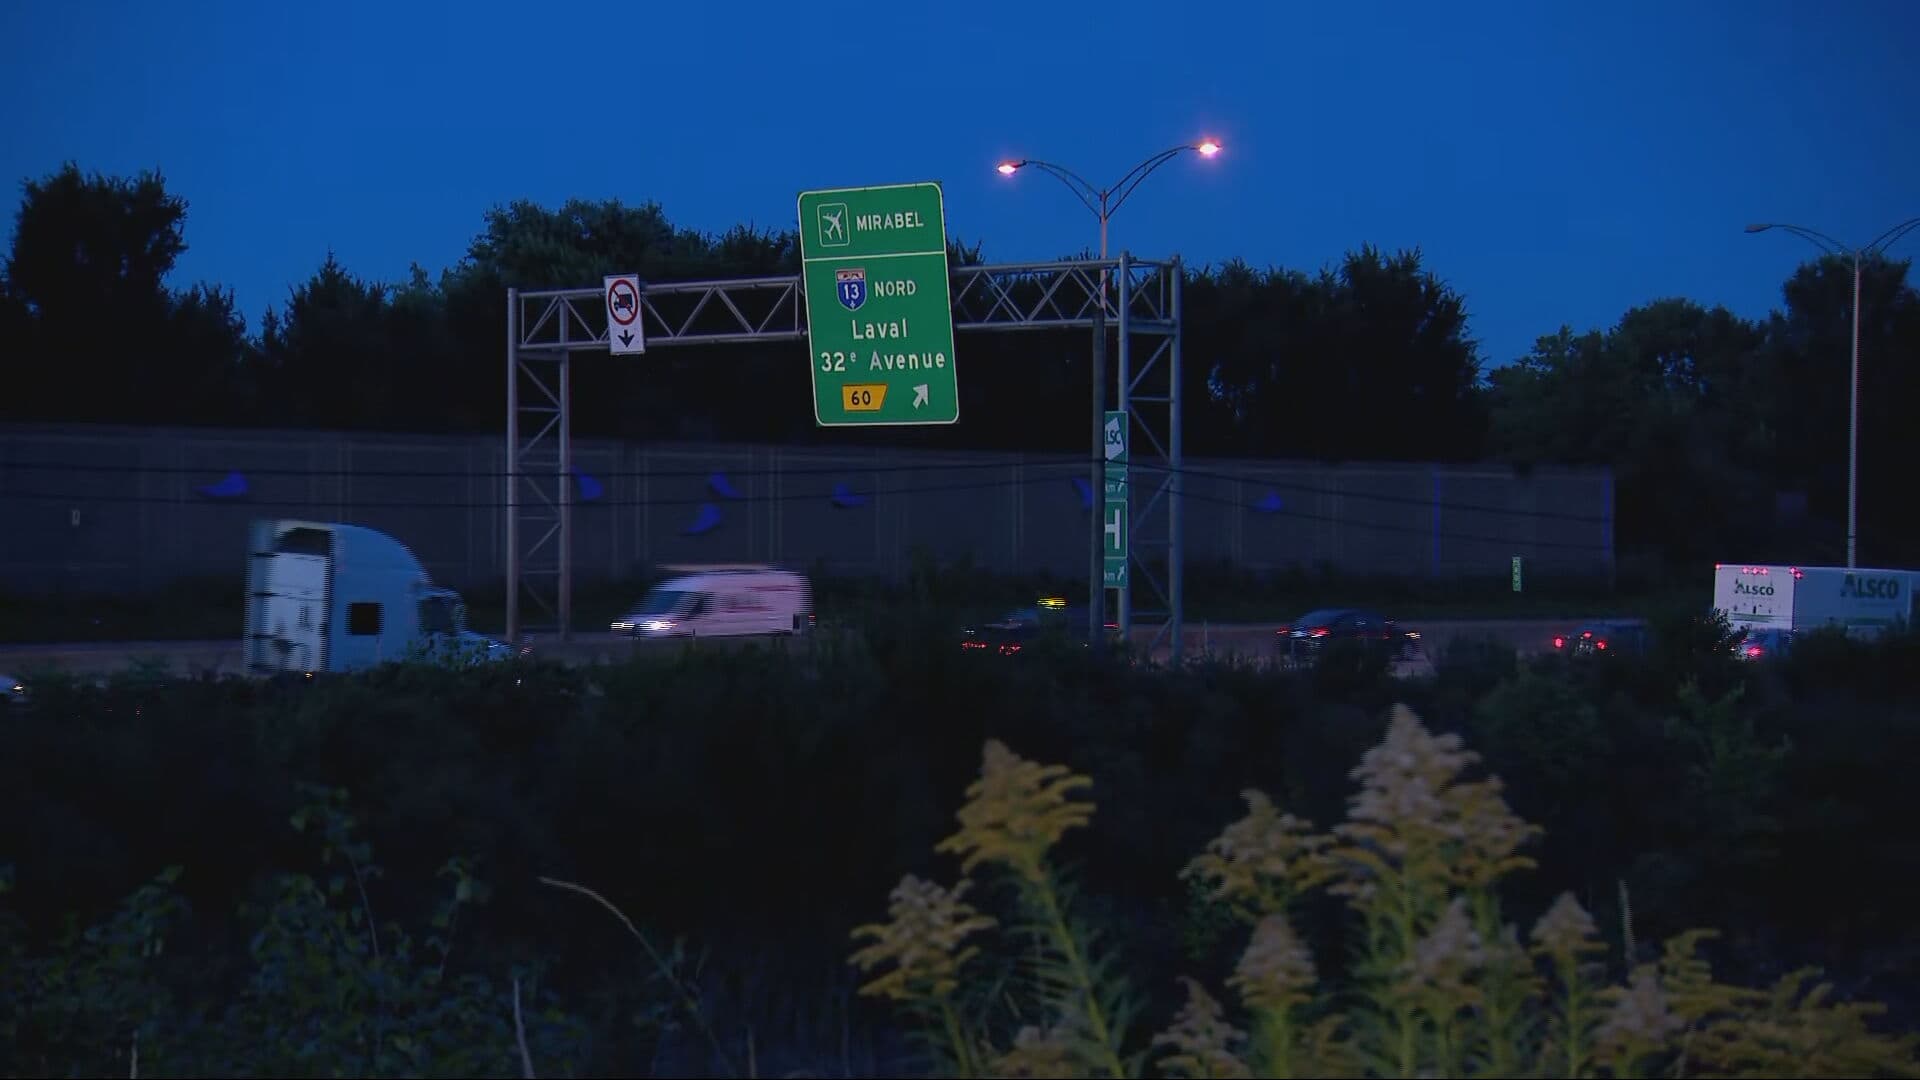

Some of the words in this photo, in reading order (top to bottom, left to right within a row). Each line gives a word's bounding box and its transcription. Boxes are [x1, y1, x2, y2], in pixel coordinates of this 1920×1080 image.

[856, 212, 924, 231] MIRABEL
[843, 283, 860, 301] 13
[874, 280, 916, 297] NORD
[852, 318, 908, 340] Laval
[869, 351, 945, 371] Avenue
[851, 390, 871, 406] 60
